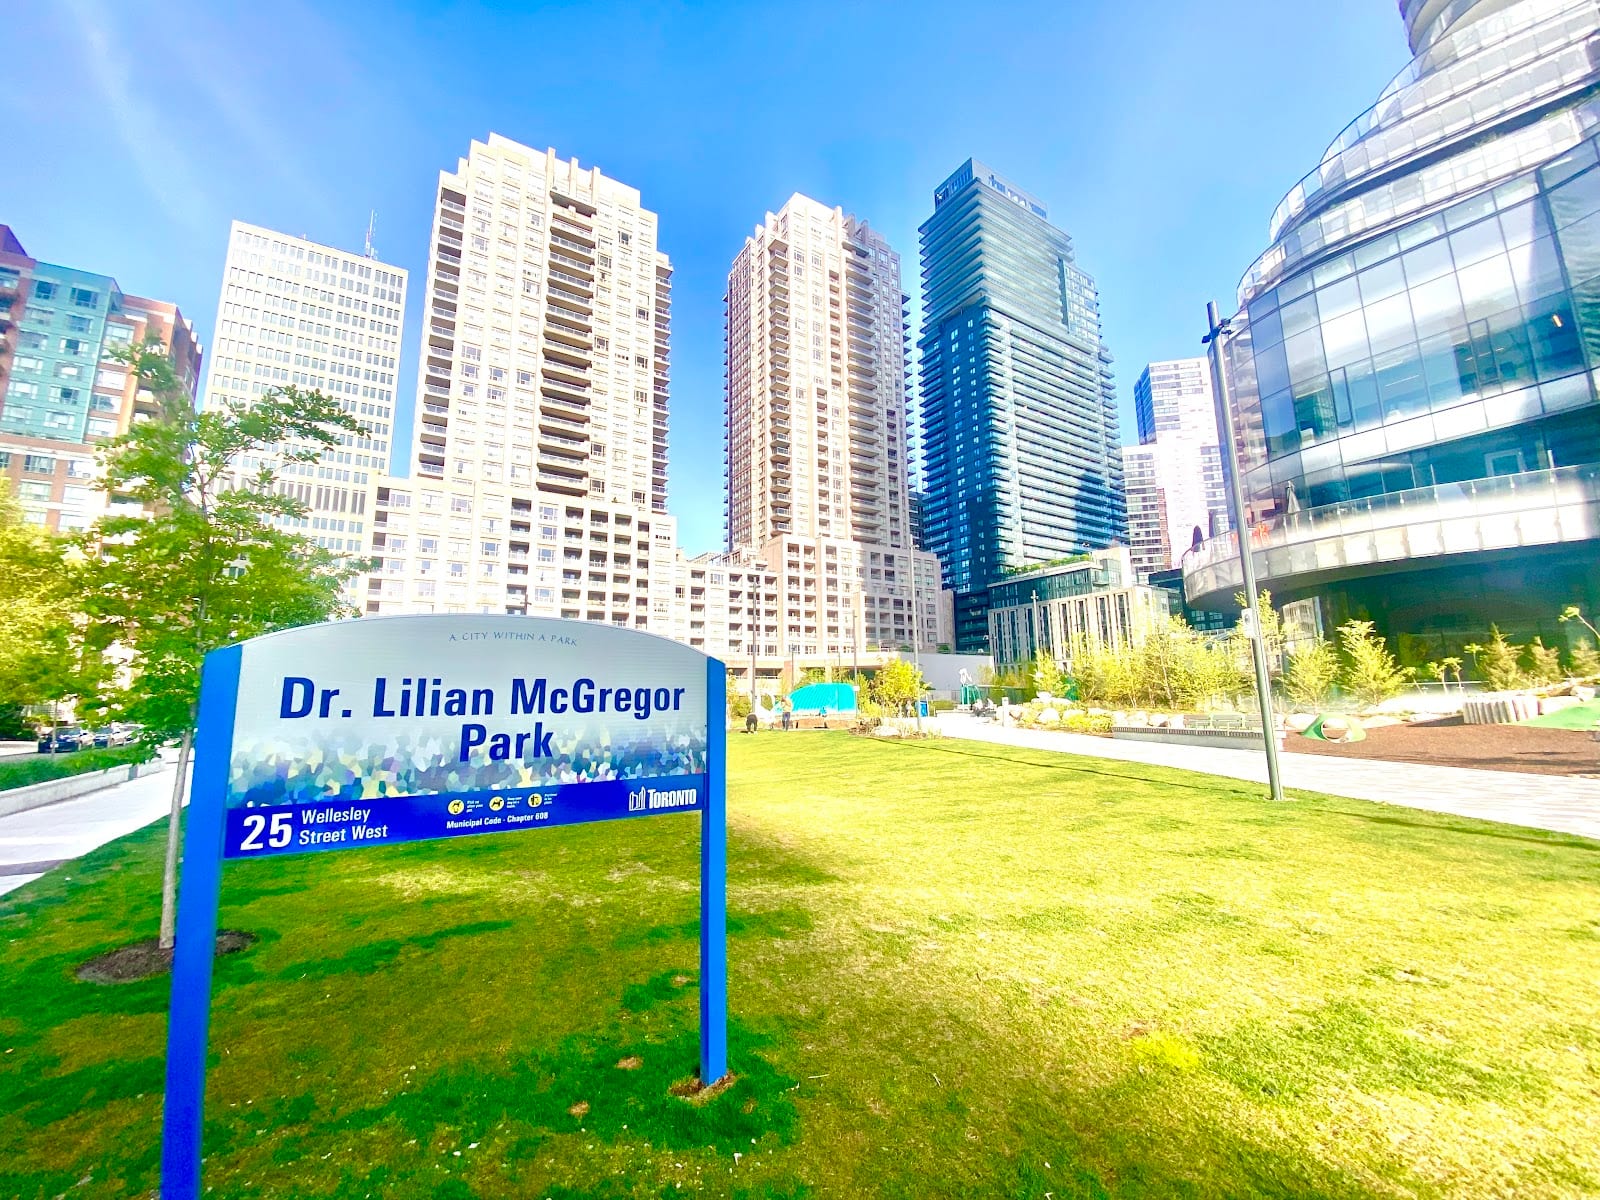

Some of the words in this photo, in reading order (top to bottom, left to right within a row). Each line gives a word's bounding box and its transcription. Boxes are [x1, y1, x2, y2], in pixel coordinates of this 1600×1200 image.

[462, 632, 488, 641] CITY
[493, 631, 535, 641] WITHIN
[538, 634, 546, 642] A
[550, 634, 577, 647] PARK
[279, 676, 352, 719] Dr.
[373, 677, 494, 717] Lilian
[510, 678, 685, 720] McGregor
[459, 722, 554, 763] Park
[647, 788, 697, 809] TORONTO
[301, 806, 371, 825] Wellesley
[446, 817, 482, 829] Municipal
[484, 816, 502, 826] Code
[507, 813, 534, 823] Chapter
[240, 812, 293, 851] 25
[299, 828, 346, 846] Street
[351, 824, 388, 841] West
